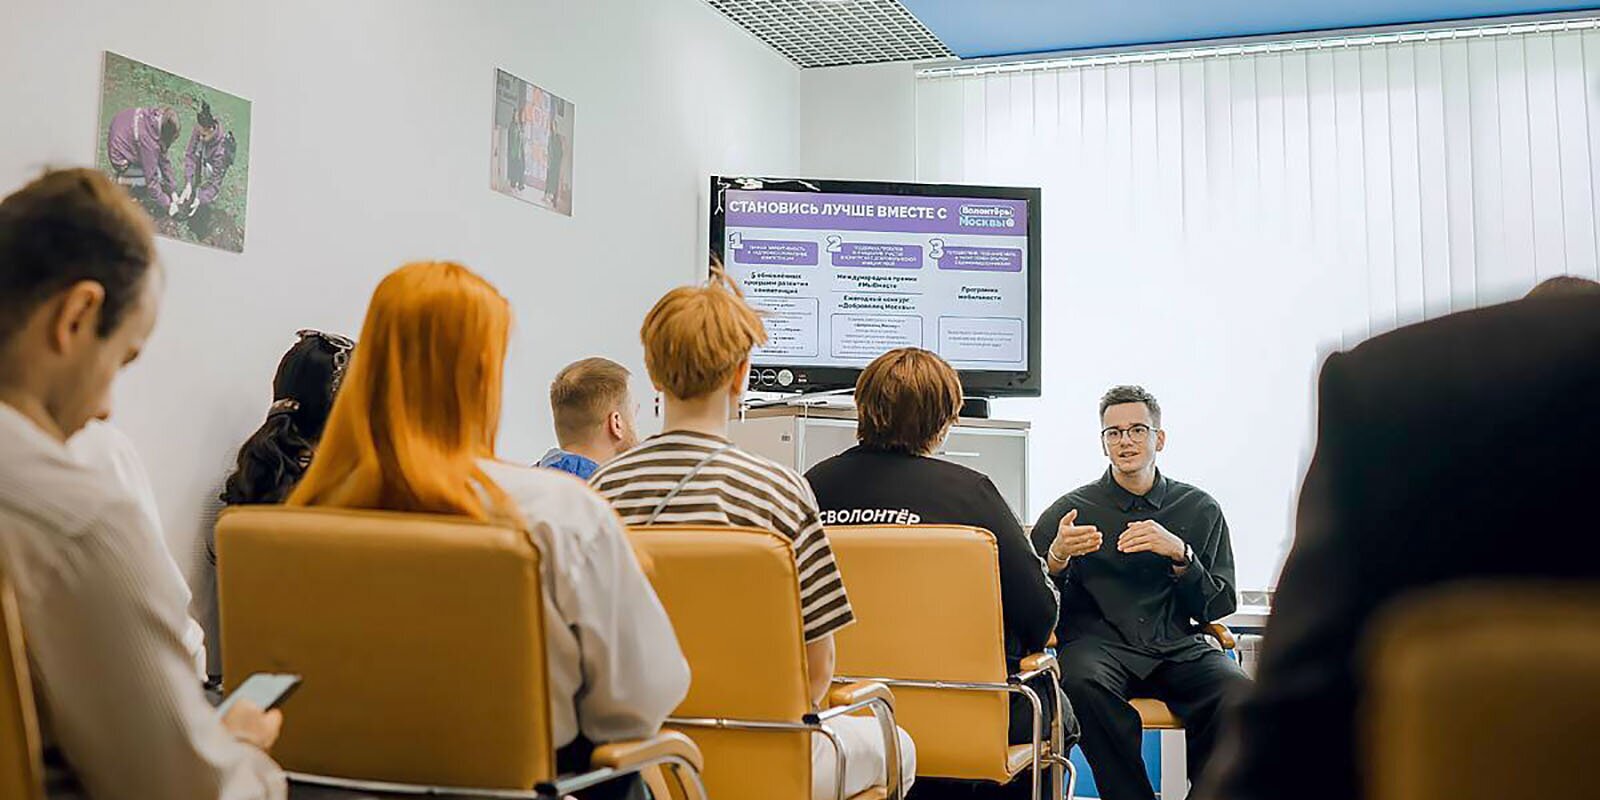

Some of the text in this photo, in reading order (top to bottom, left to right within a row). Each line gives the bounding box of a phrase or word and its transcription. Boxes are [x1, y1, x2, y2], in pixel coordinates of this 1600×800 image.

[729, 200, 947, 219] СТАНОВИСЬ ЛУЧШЕ ВМЕСТЕ С
[962, 207, 1012, 217] Волонтёры
[960, 216, 1005, 227] Москвы
[729, 232, 743, 249] 1
[826, 235, 842, 253] 2
[928, 238, 945, 259] 3
